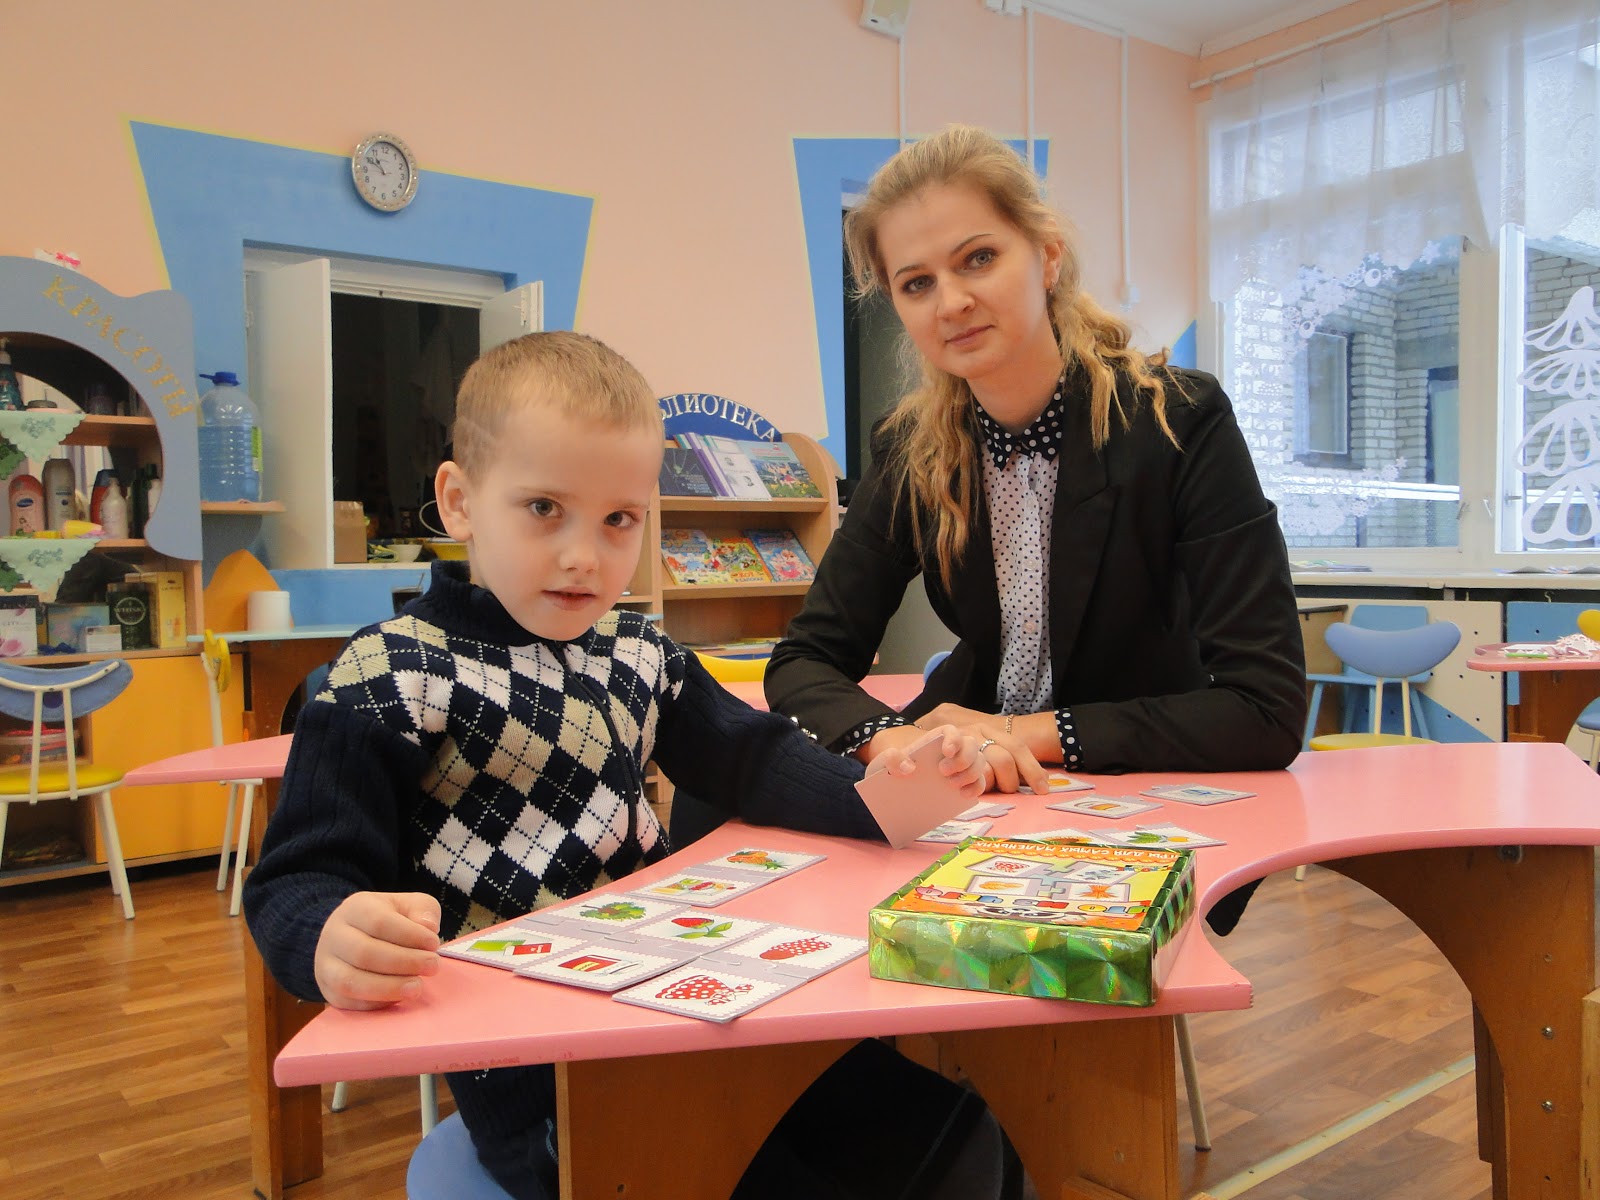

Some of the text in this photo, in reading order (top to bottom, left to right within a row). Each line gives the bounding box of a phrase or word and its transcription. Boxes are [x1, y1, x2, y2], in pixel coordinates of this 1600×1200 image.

[372, 149, 378, 157] 11
[363, 165, 368, 173] 9
[365, 175, 369, 183] 8
[42, 275, 193, 419] КРАСОТЫ
[975, 842, 1056, 852] МАЛЕНЬКИХ
[1059, 846, 1110, 855] САМЫХ
[1013, 899, 1069, 909] ИЗ
